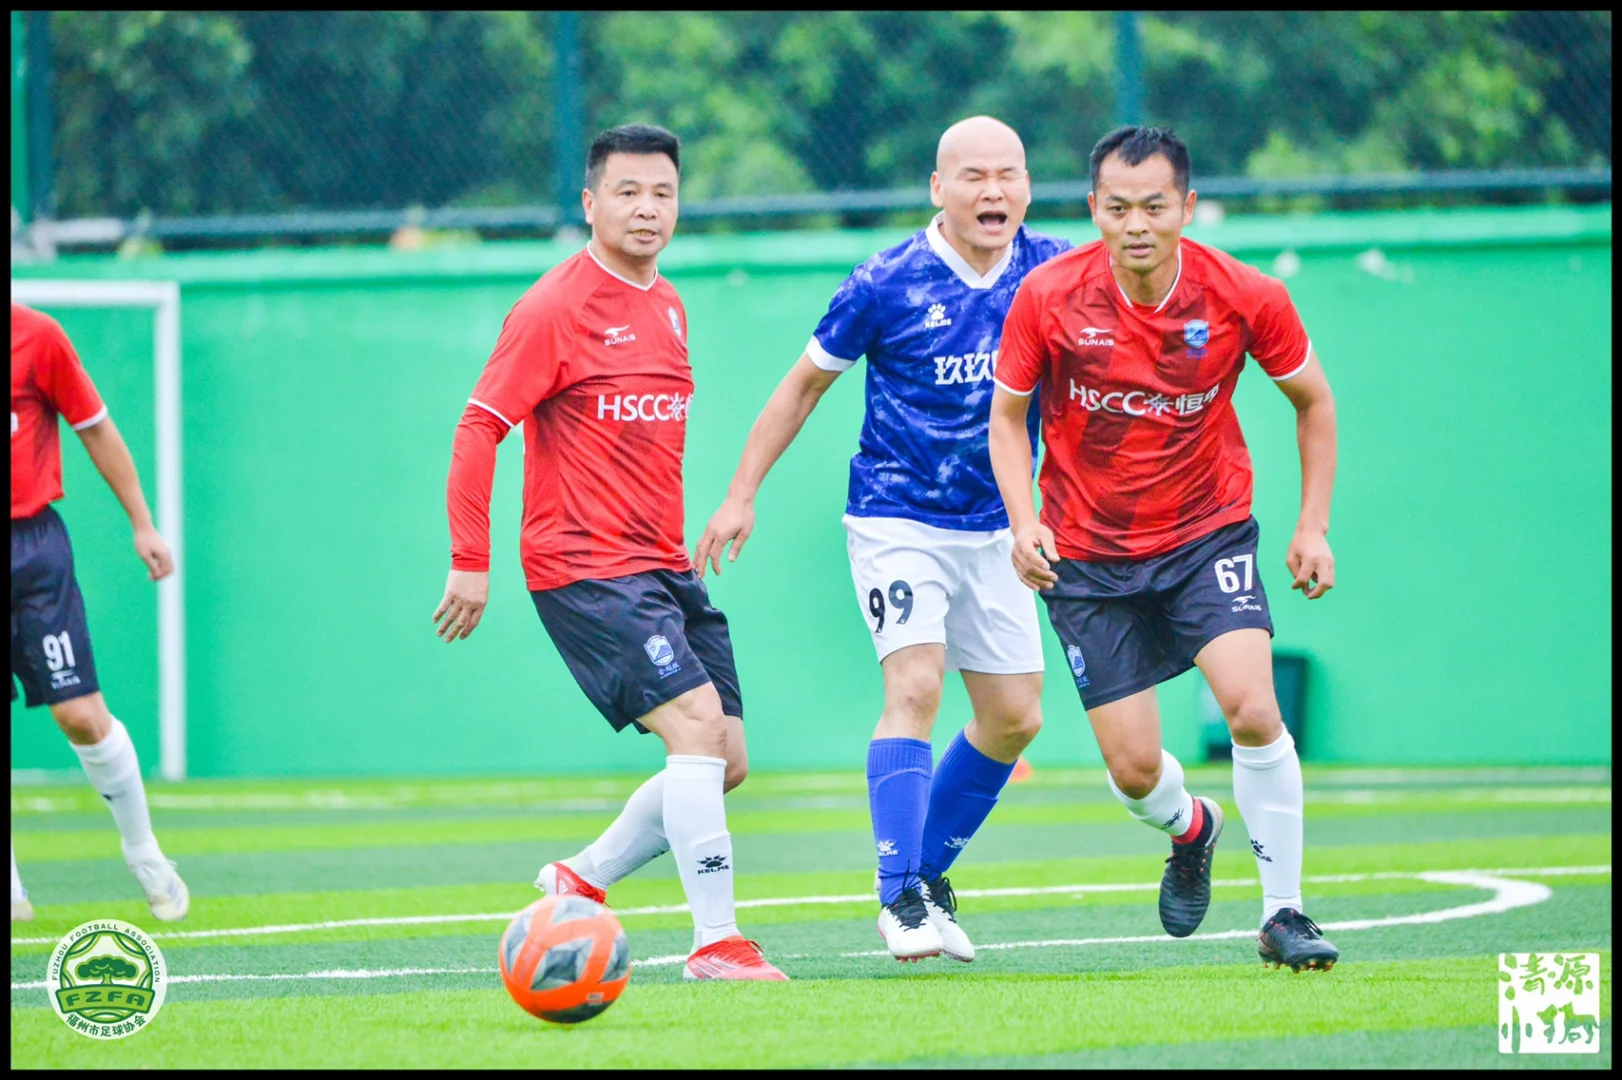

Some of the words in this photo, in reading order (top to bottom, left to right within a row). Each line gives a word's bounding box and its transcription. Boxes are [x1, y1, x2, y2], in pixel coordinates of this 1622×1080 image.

[604, 334, 636, 346] SUNAIS
[1078, 338, 1115, 347] SUNAIS
[933, 350, 999, 385] 玖玖
[597, 394, 668, 422] HSCC
[1214, 554, 1253, 593] 67
[869, 580, 914, 633] 99
[42, 630, 76, 671] 91
[697, 864, 730, 875] KELME
